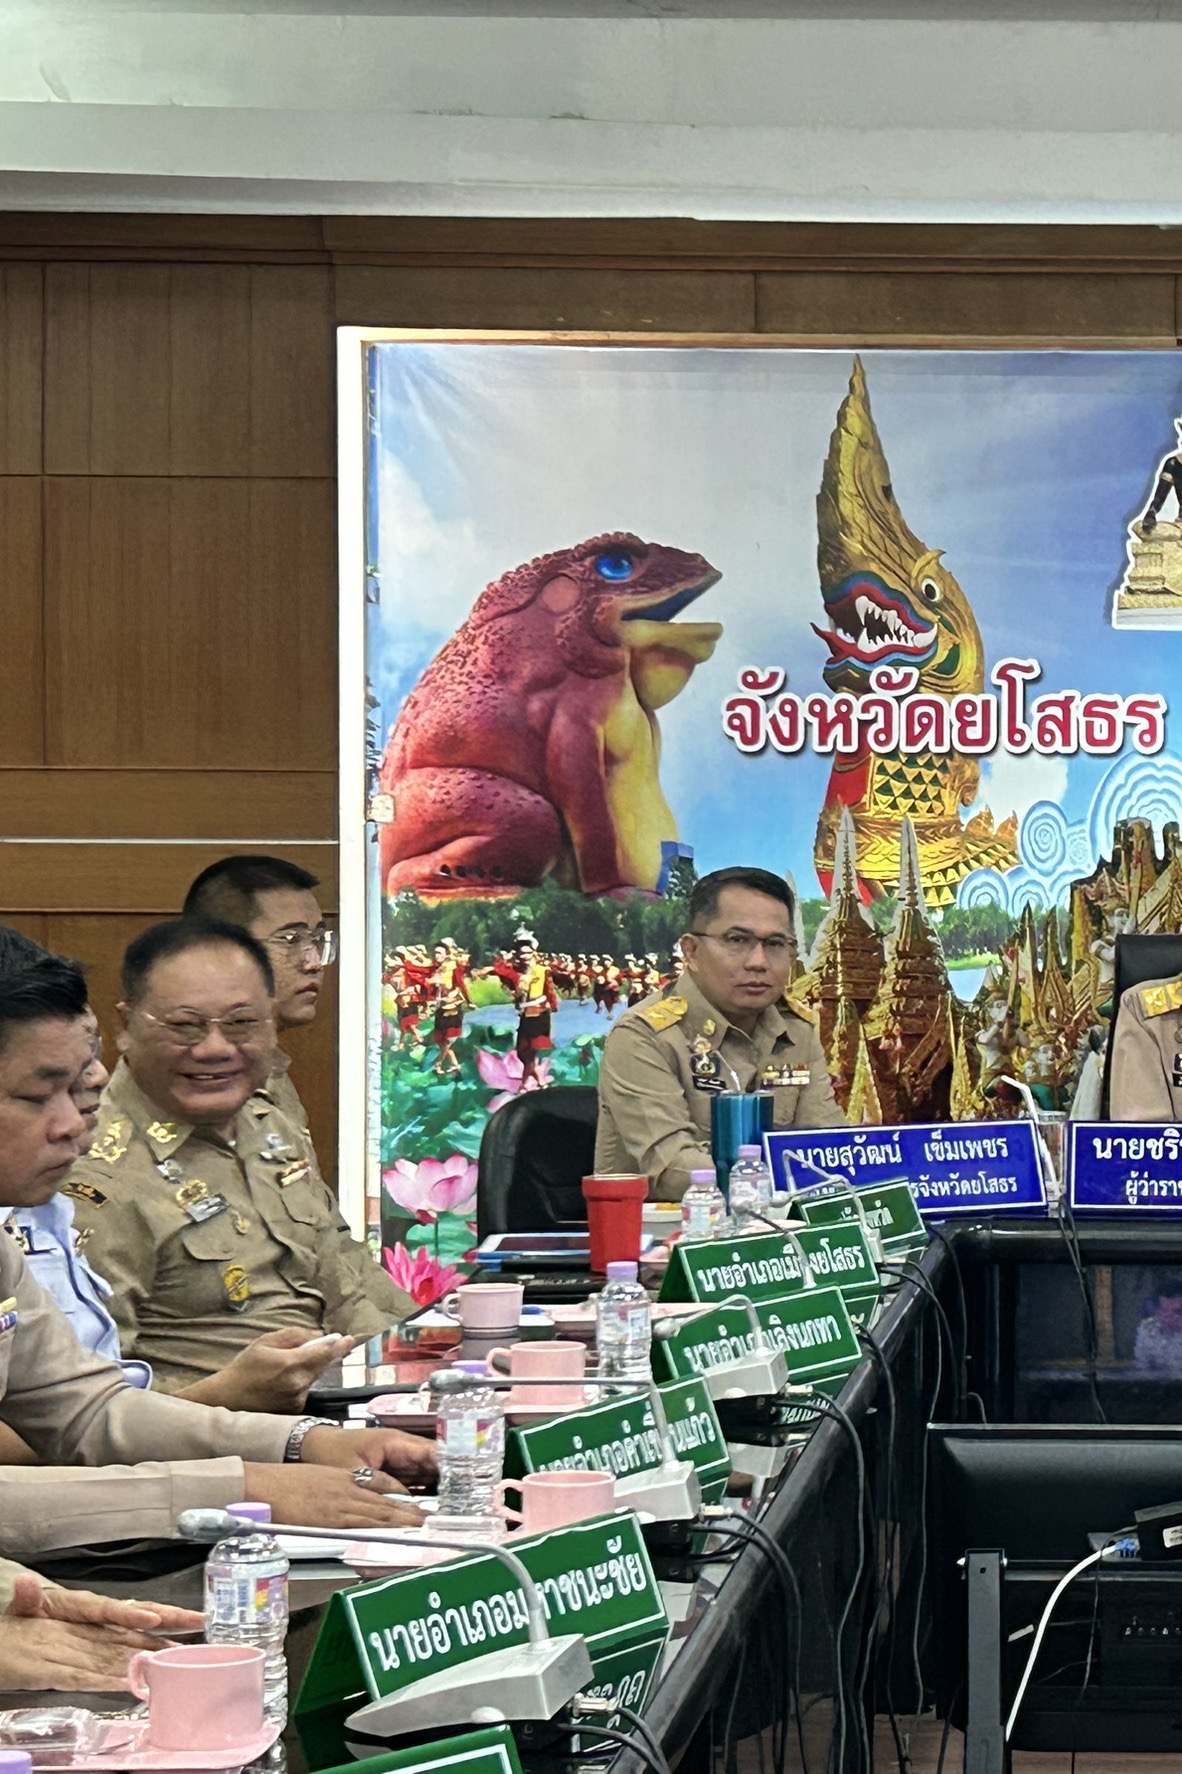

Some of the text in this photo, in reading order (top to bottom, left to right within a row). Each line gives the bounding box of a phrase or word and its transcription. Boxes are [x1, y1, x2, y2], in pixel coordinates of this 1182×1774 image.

[724, 660, 1165, 752] จังหวัดยโสธร
[923, 1128, 1009, 1163] เข็มเพชร
[696, 1237, 866, 1293] นายอำเภอเมืงยโสธร
